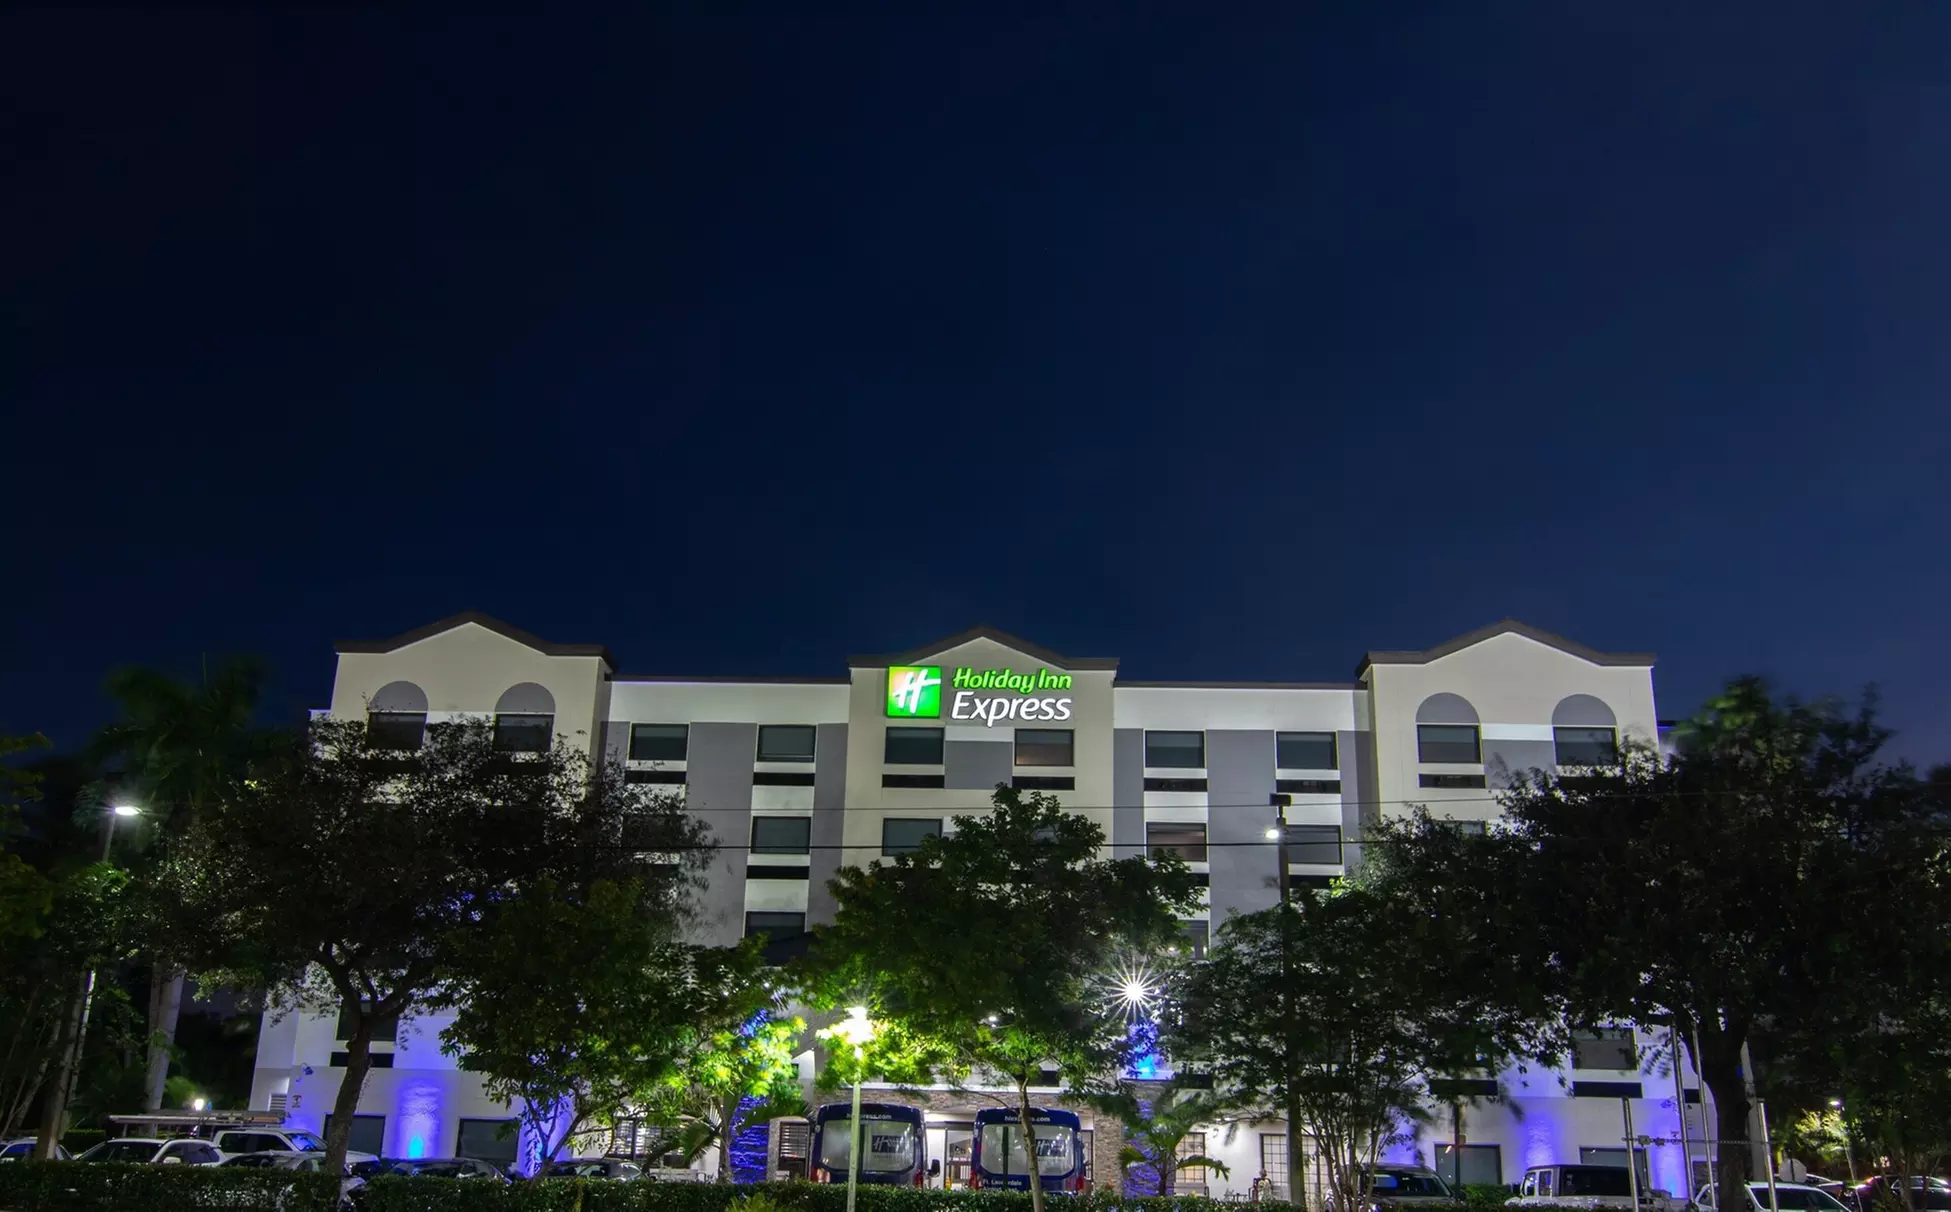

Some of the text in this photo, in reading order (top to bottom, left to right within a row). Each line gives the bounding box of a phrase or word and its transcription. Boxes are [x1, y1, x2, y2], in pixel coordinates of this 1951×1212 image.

[892, 668, 941, 714] H
[953, 667, 1072, 694] Holiday Inn
[951, 691, 1072, 727] Express
